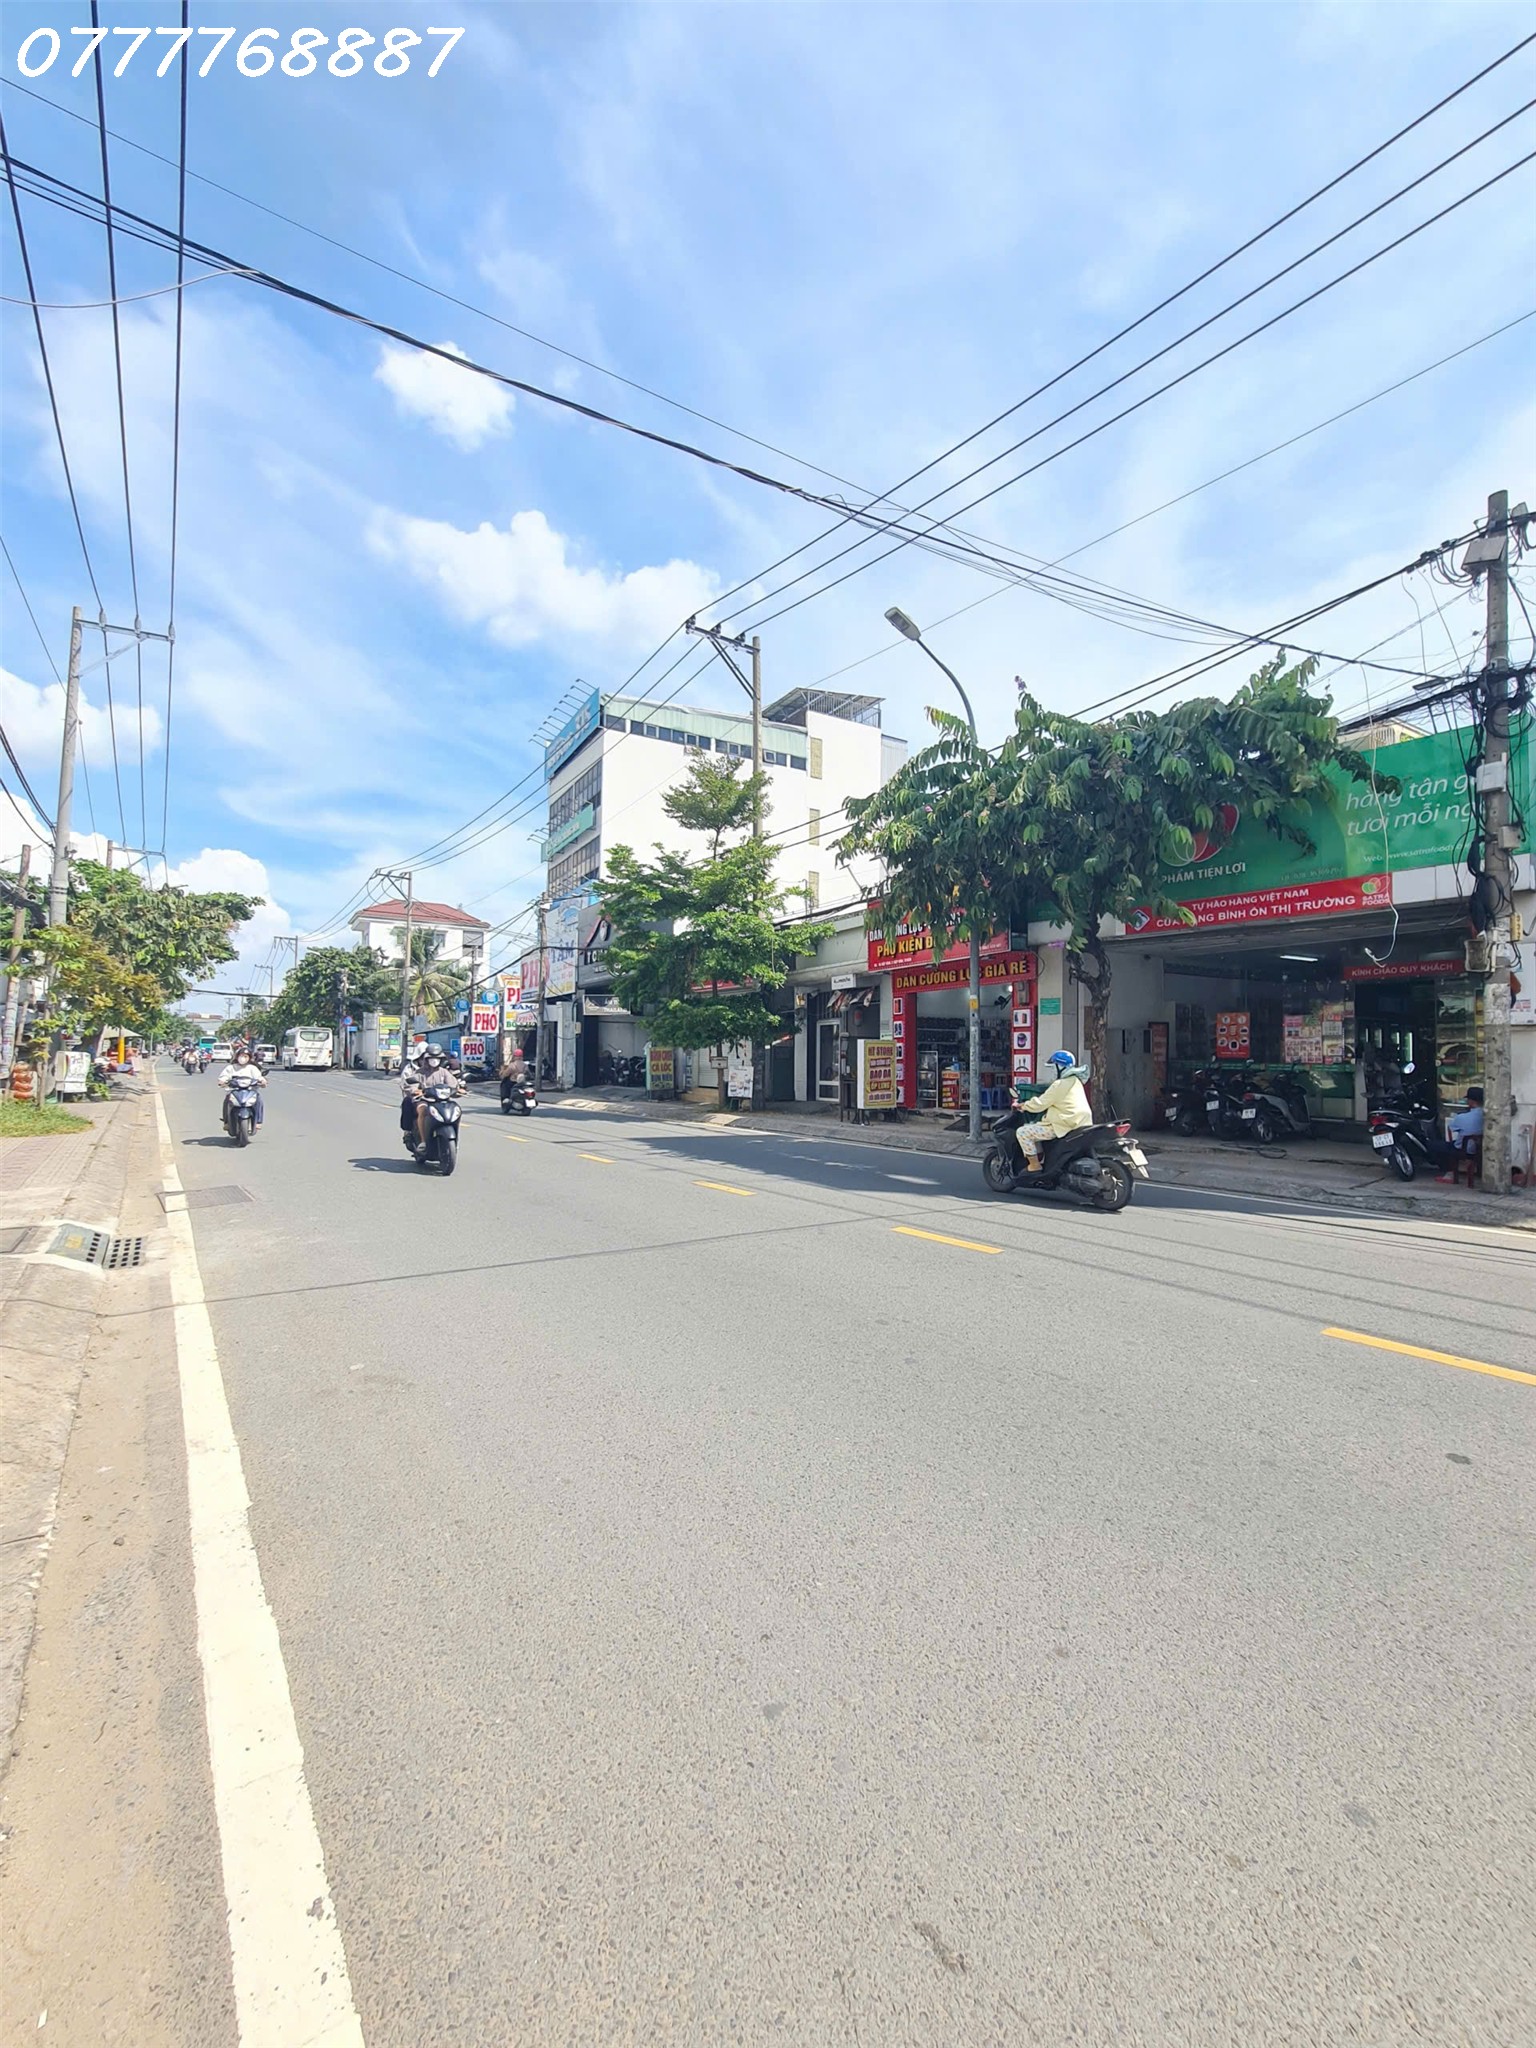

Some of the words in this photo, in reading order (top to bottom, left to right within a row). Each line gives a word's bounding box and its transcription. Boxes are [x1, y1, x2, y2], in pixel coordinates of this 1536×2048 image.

[1409, 777, 1447, 800] tận
[1347, 811, 1388, 835] tươi
[1395, 802, 1440, 826] mỗi
[1197, 865, 1223, 880] TIỆN
[1226, 862, 1246, 876] LỢI
[1192, 902, 1205, 912] TỰ
[1207, 899, 1226, 909] HÀO
[1229, 895, 1257, 907] HÀNG
[1259, 892, 1281, 903] VIỆT
[1284, 889, 1309, 899] NAM
[1218, 909, 1246, 921] BÌNH
[1271, 904, 1291, 914] THỊ
[1295, 895, 1356, 911] TRƯỜNG
[898, 936, 924, 954] KIỆN
[896, 972, 917, 988] DÁN
[919, 968, 956, 986] CƯỜNG
[984, 959, 1006, 978] GIÁ
[1352, 967, 1371, 976] KÍNH
[1373, 965, 1397, 975] CHÀO
[1421, 962, 1453, 972] KHÁCH
[474, 1006, 498, 1031] PHỞ
